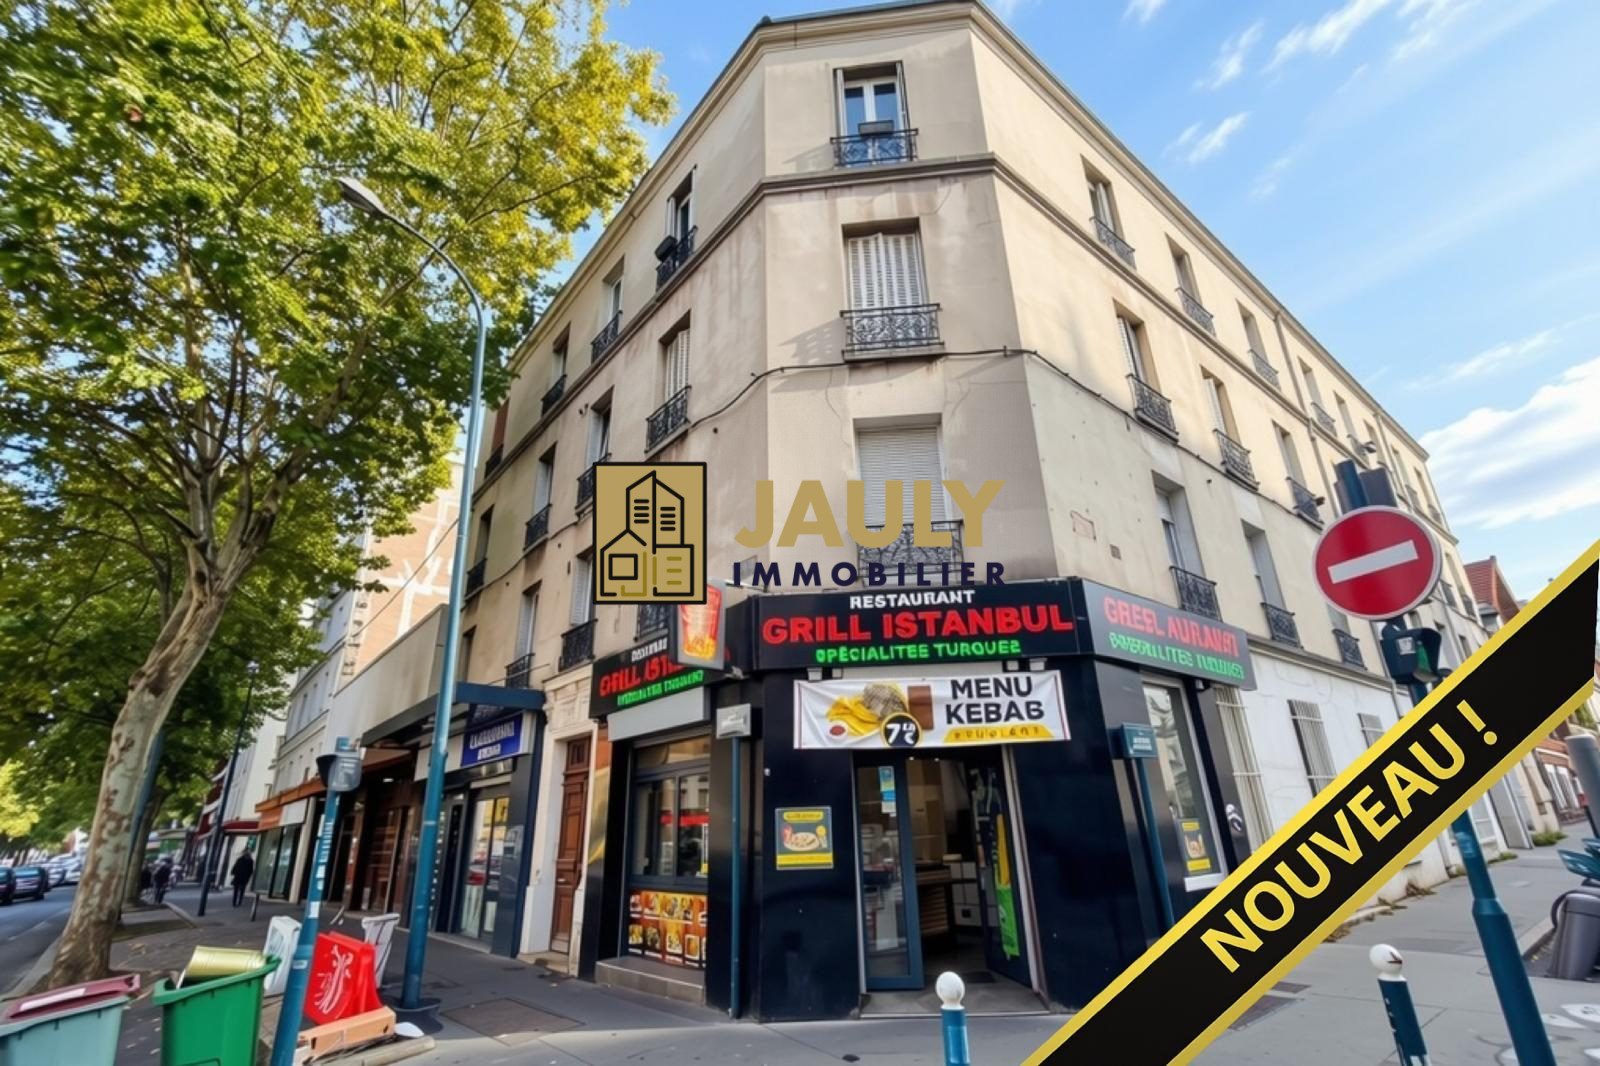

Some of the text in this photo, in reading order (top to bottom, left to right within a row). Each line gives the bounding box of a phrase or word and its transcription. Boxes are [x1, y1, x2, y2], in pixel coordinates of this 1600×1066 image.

[850, 589, 976, 609] RESTAURANT
[762, 604, 1074, 645] GRILL ISTANBUL
[951, 676, 1033, 700] MENU
